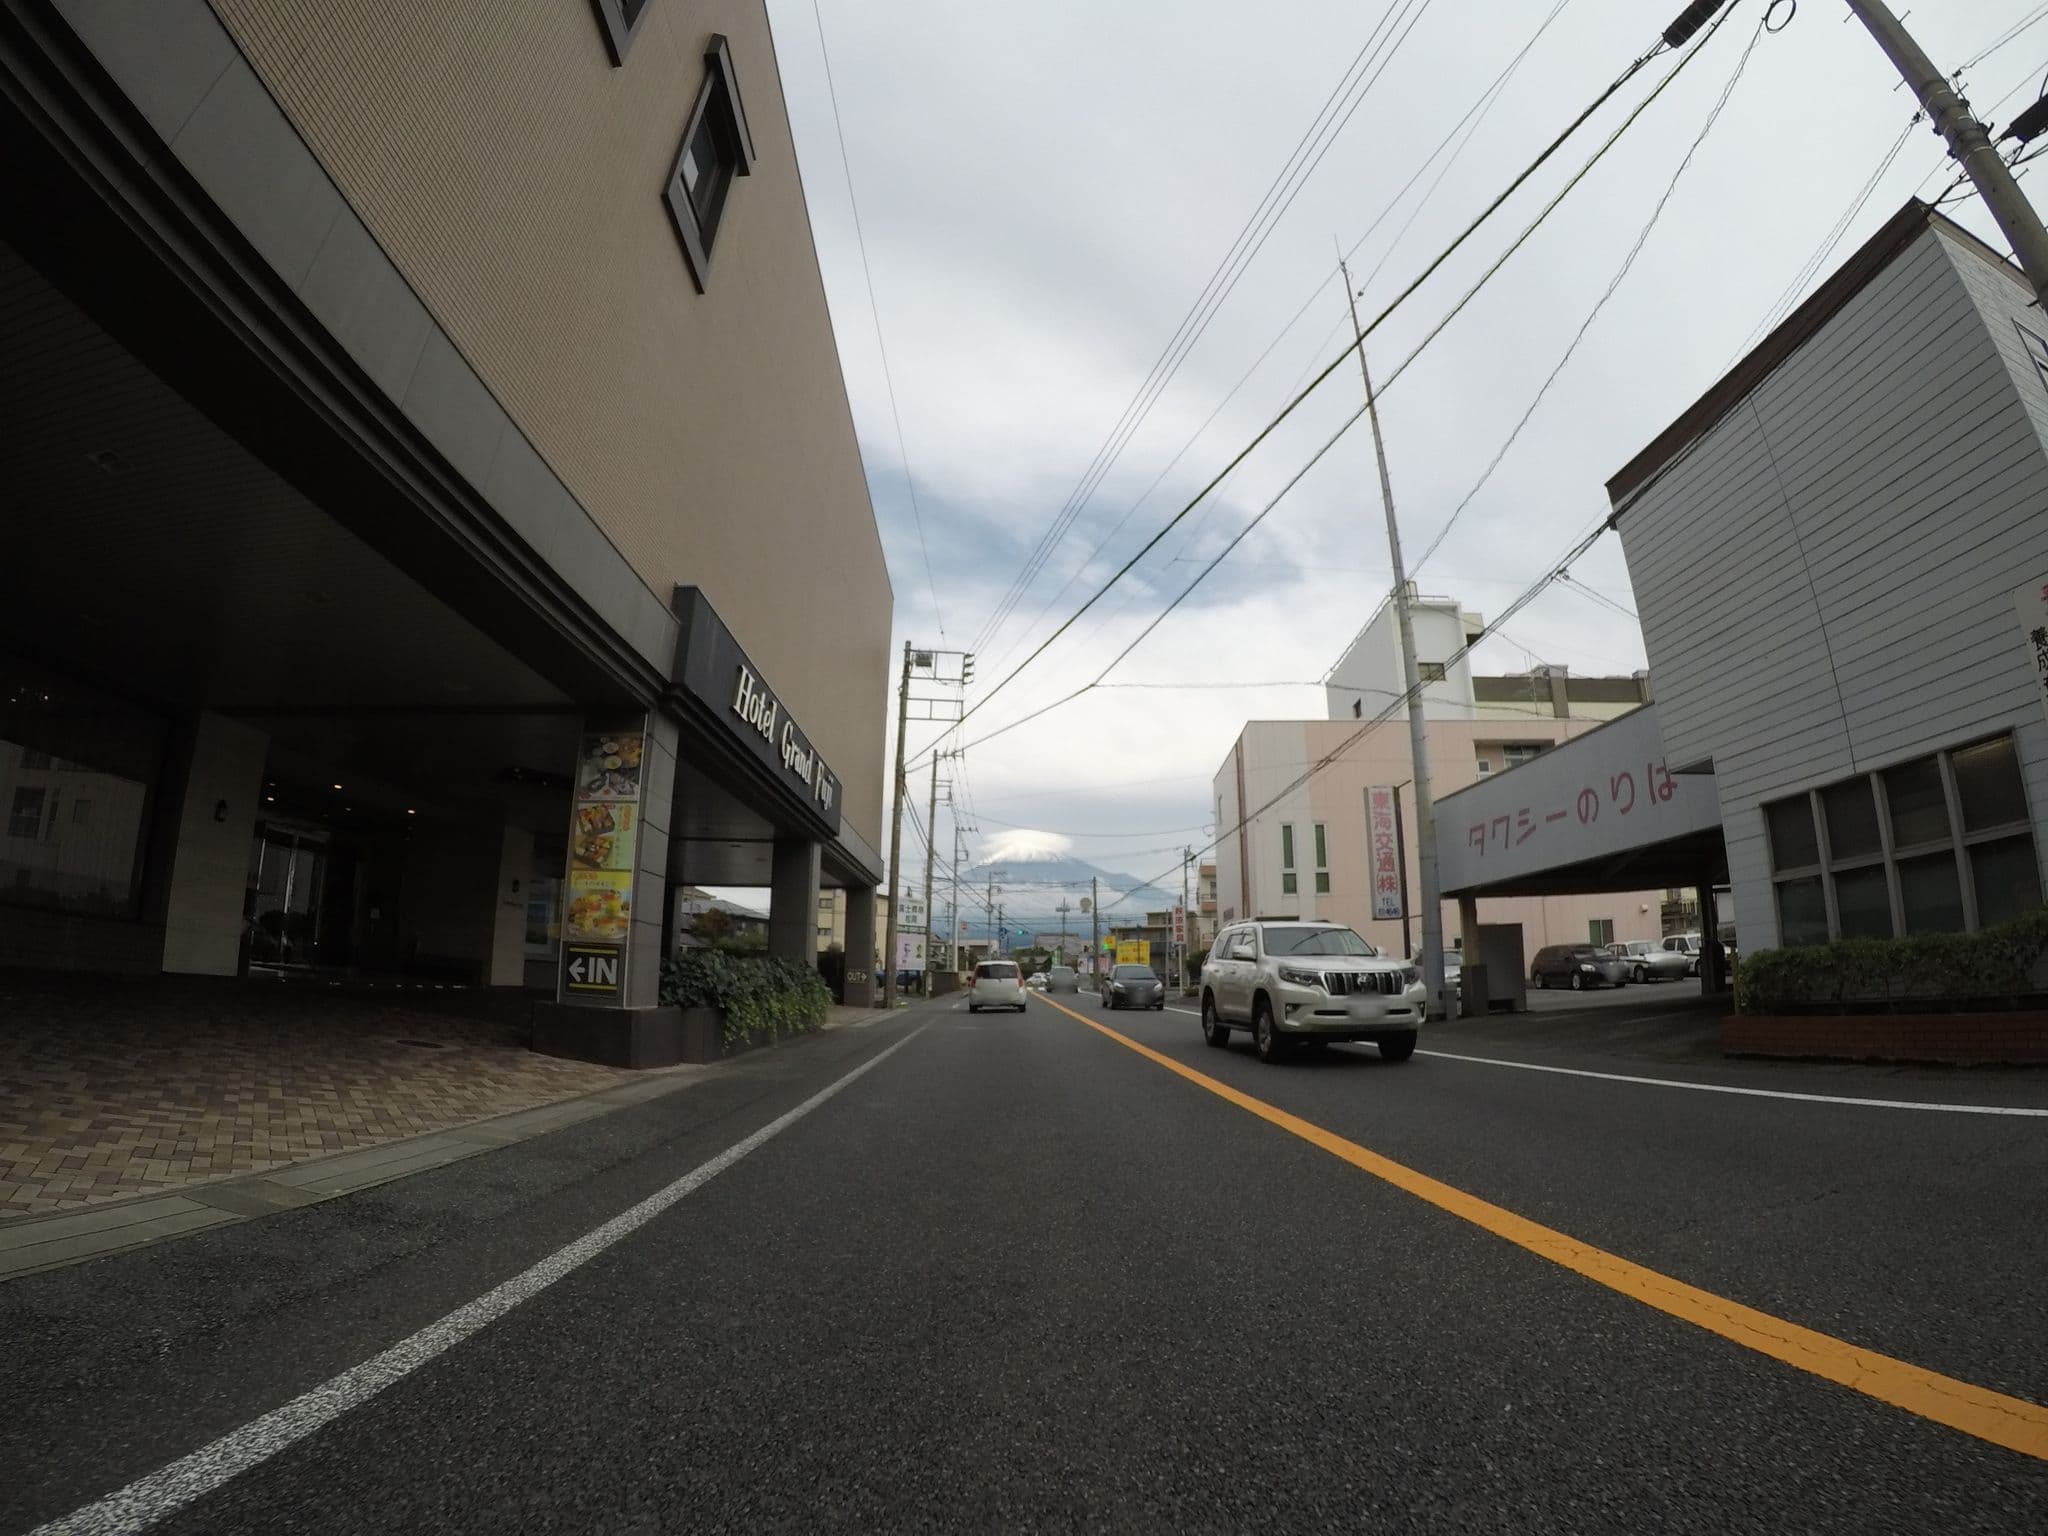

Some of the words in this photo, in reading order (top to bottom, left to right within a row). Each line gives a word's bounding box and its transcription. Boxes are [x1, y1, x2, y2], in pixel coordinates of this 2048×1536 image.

[733, 664, 778, 744] Hotel
[782, 721, 814, 785] Grand
[815, 760, 835, 811] Fuji
[1381, 897, 1394, 906] TEL
[588, 956, 618, 985] IN
[847, 971, 861, 982] OUT
